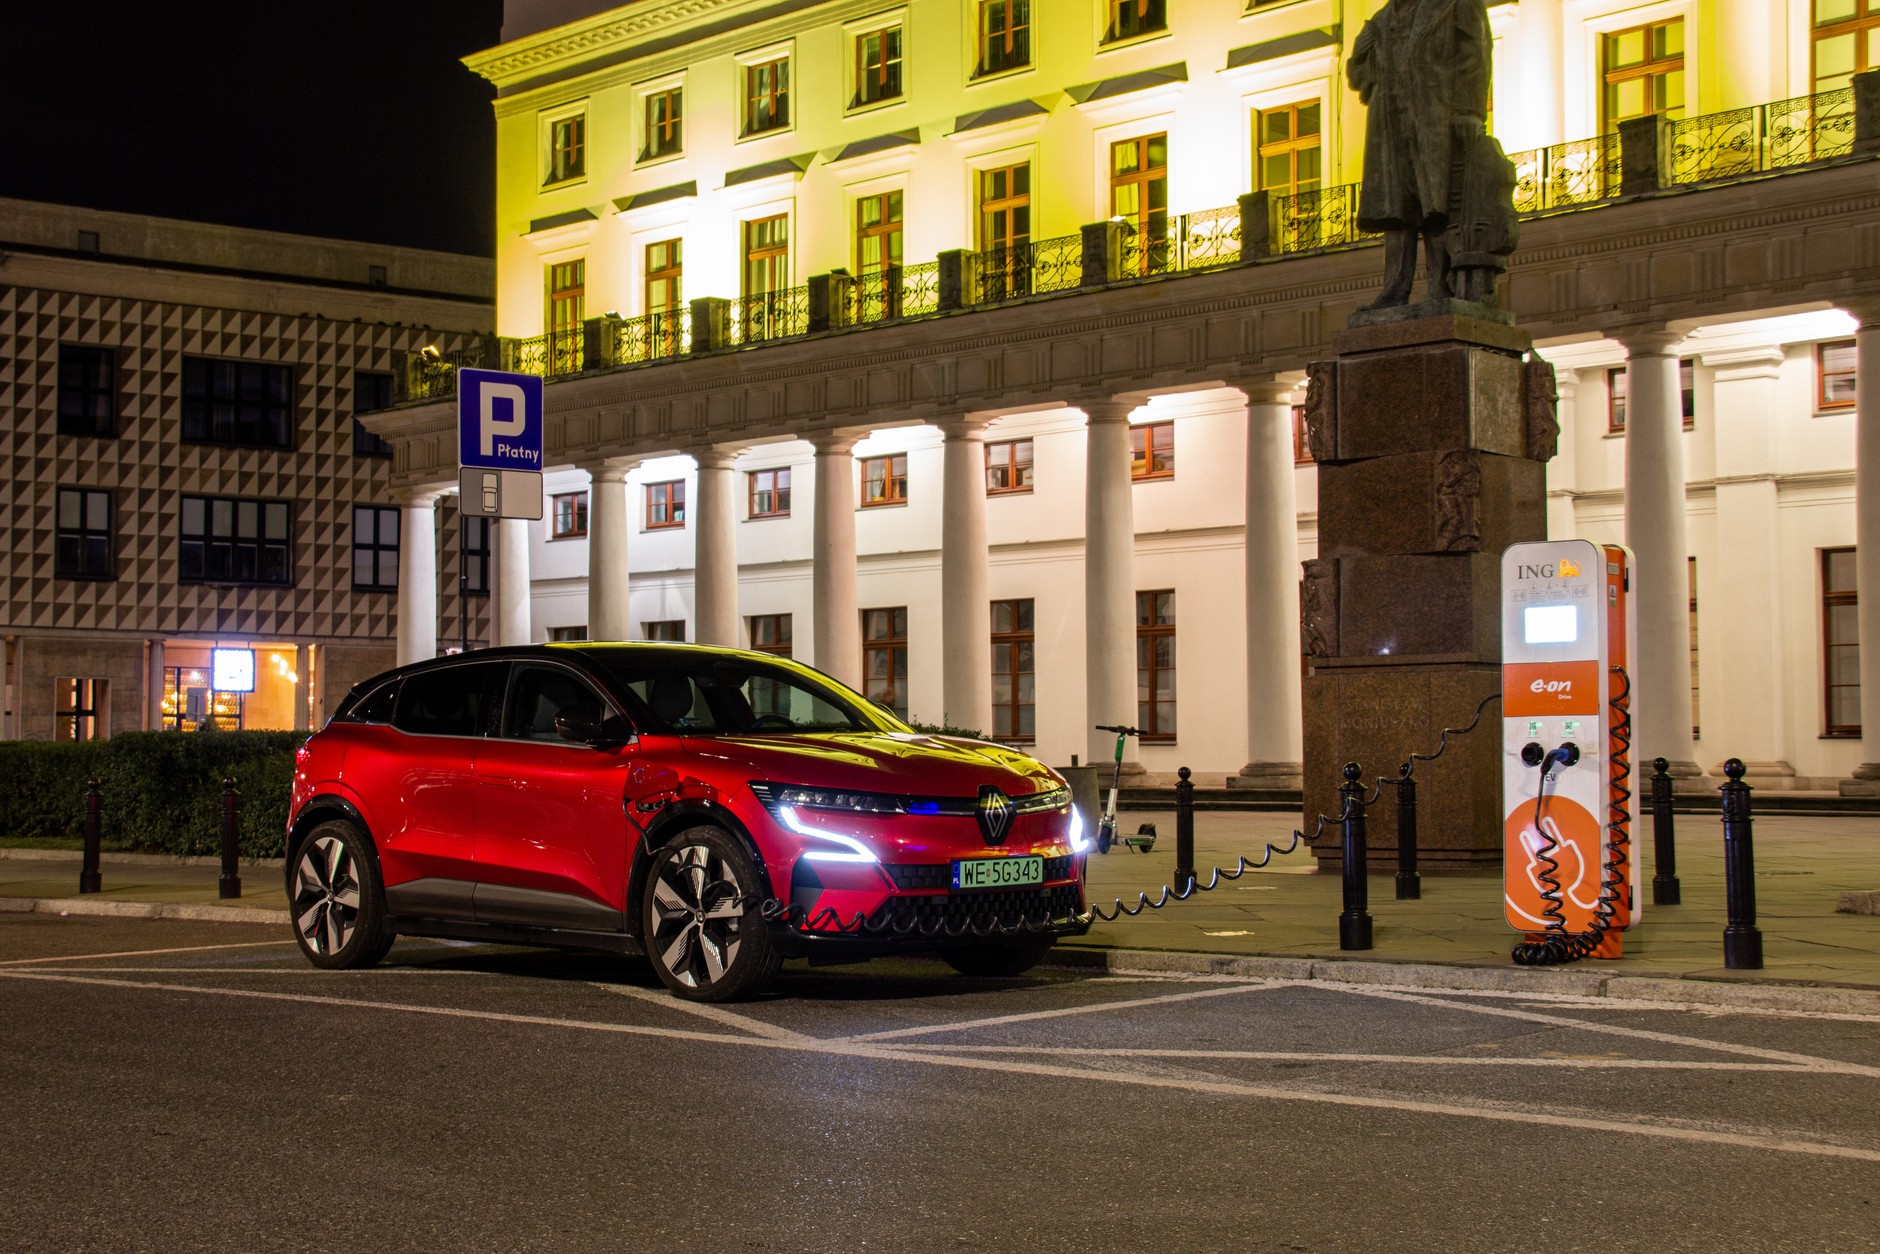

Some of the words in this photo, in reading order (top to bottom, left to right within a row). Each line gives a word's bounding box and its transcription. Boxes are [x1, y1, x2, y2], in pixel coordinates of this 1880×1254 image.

[480, 381, 525, 455] P
[497, 443, 539, 463] Płatny
[1517, 564, 1554, 579] ING
[1545, 773, 1556, 782] EV
[964, 862, 985, 885] WE
[992, 860, 1039, 883] 5G343
